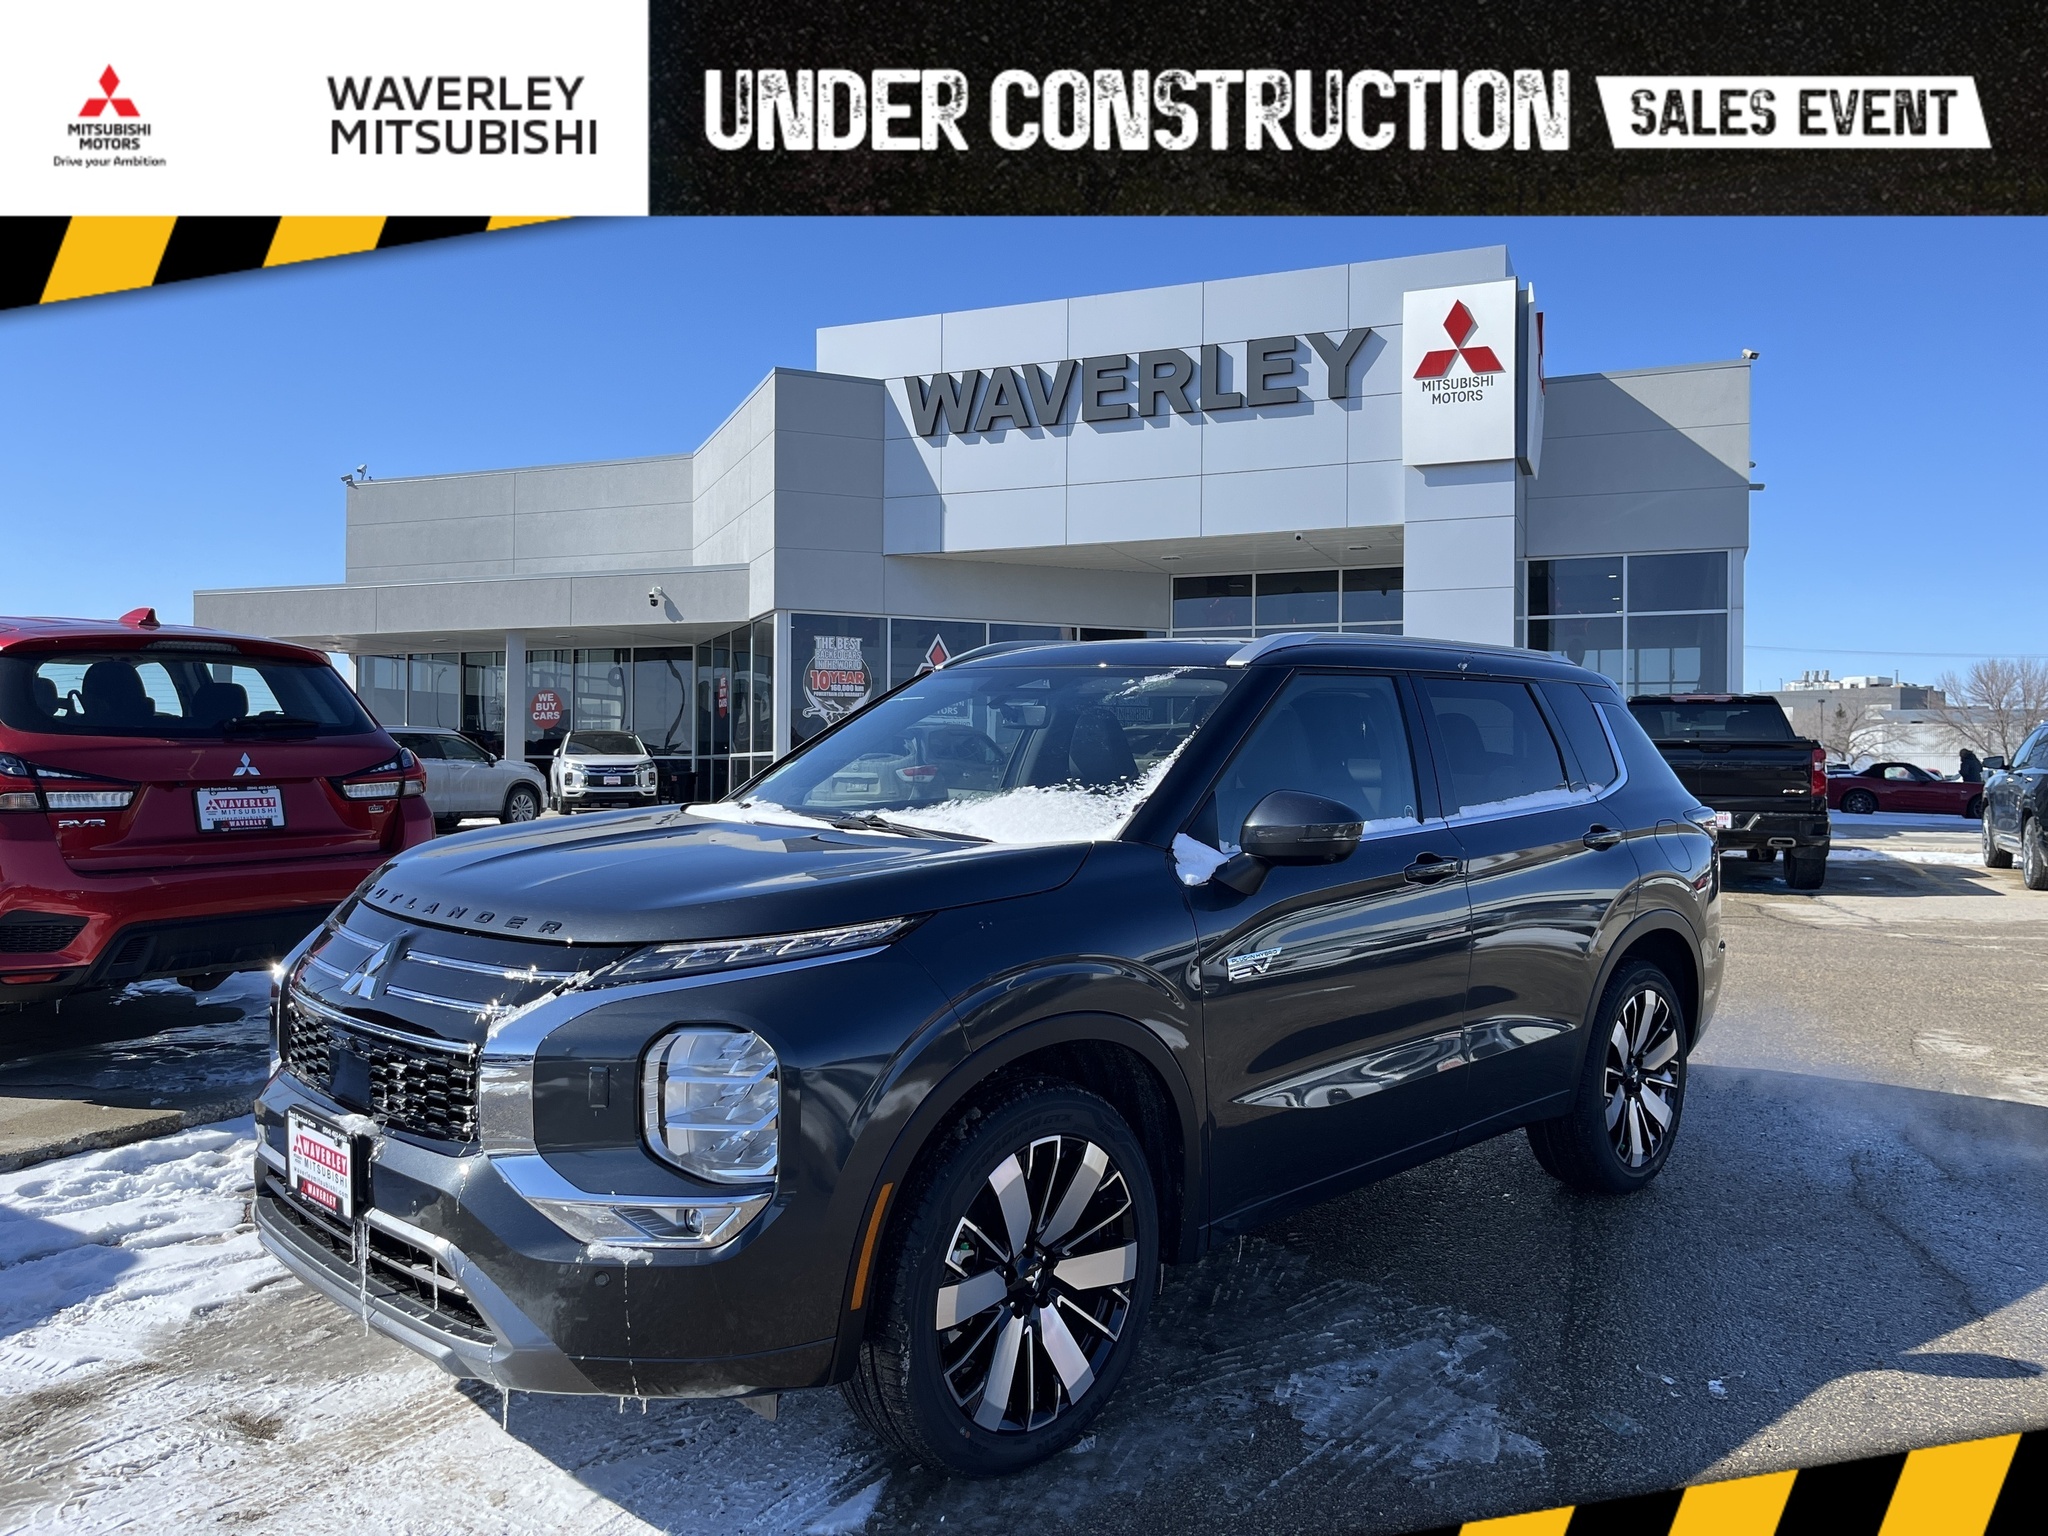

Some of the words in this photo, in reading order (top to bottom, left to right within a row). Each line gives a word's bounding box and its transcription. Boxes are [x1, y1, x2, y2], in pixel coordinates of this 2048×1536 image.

[904, 327, 1373, 437] WAVERLEY
[1422, 375, 1494, 393] MITSUBISHI
[1432, 390, 1484, 405] MOTORS
[814, 635, 835, 649] THE
[836, 636, 863, 650] BEST
[843, 650, 863, 660] CARS
[720, 677, 727, 687] WE
[810, 670, 830, 691] 10
[829, 671, 866, 684] YEAR
[538, 693, 554, 702] WE
[535, 702, 557, 711] BUY
[532, 711, 561, 720] CARS
[219, 798, 275, 808] WAVERLEY
[58, 819, 106, 828] RVR
[362, 883, 563, 934] OUTLANDER
[302, 1138, 347, 1173] WAVERLEY
[304, 1158, 348, 1188] MITSUBISHI
[307, 1183, 337, 1208] WAVERLEY
